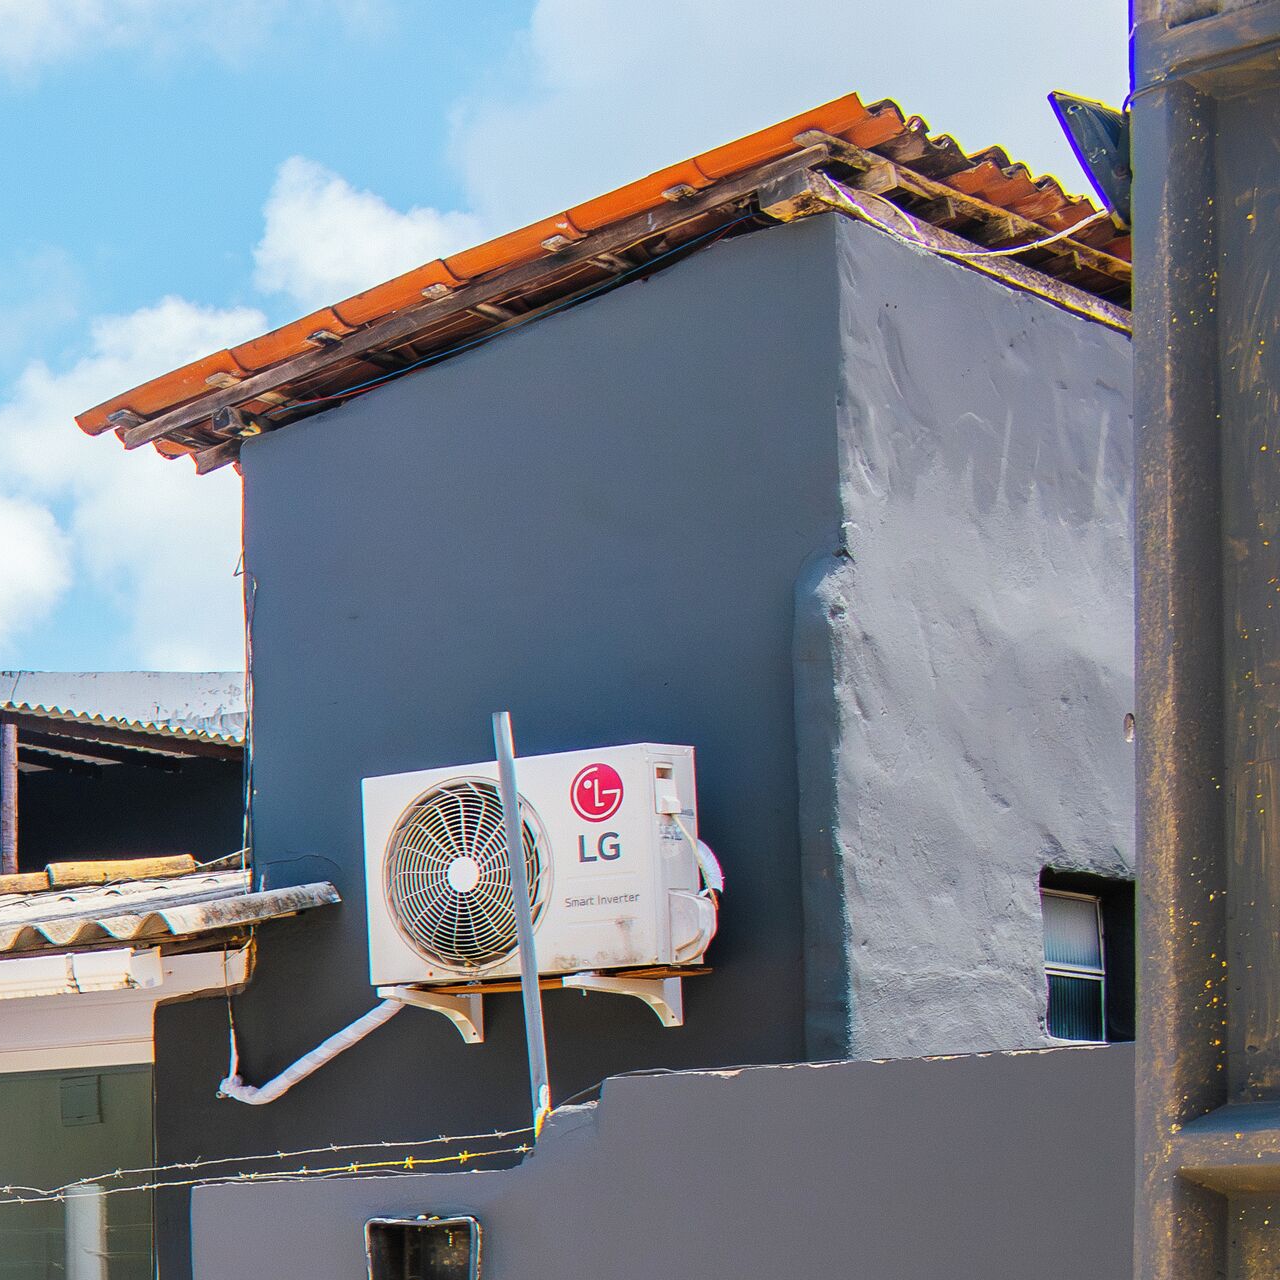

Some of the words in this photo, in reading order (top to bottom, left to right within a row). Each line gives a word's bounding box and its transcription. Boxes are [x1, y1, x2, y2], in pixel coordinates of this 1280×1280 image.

[579, 832, 620, 862] LG
[565, 897, 595, 908] Smart
[598, 894, 640, 905] Inverter
